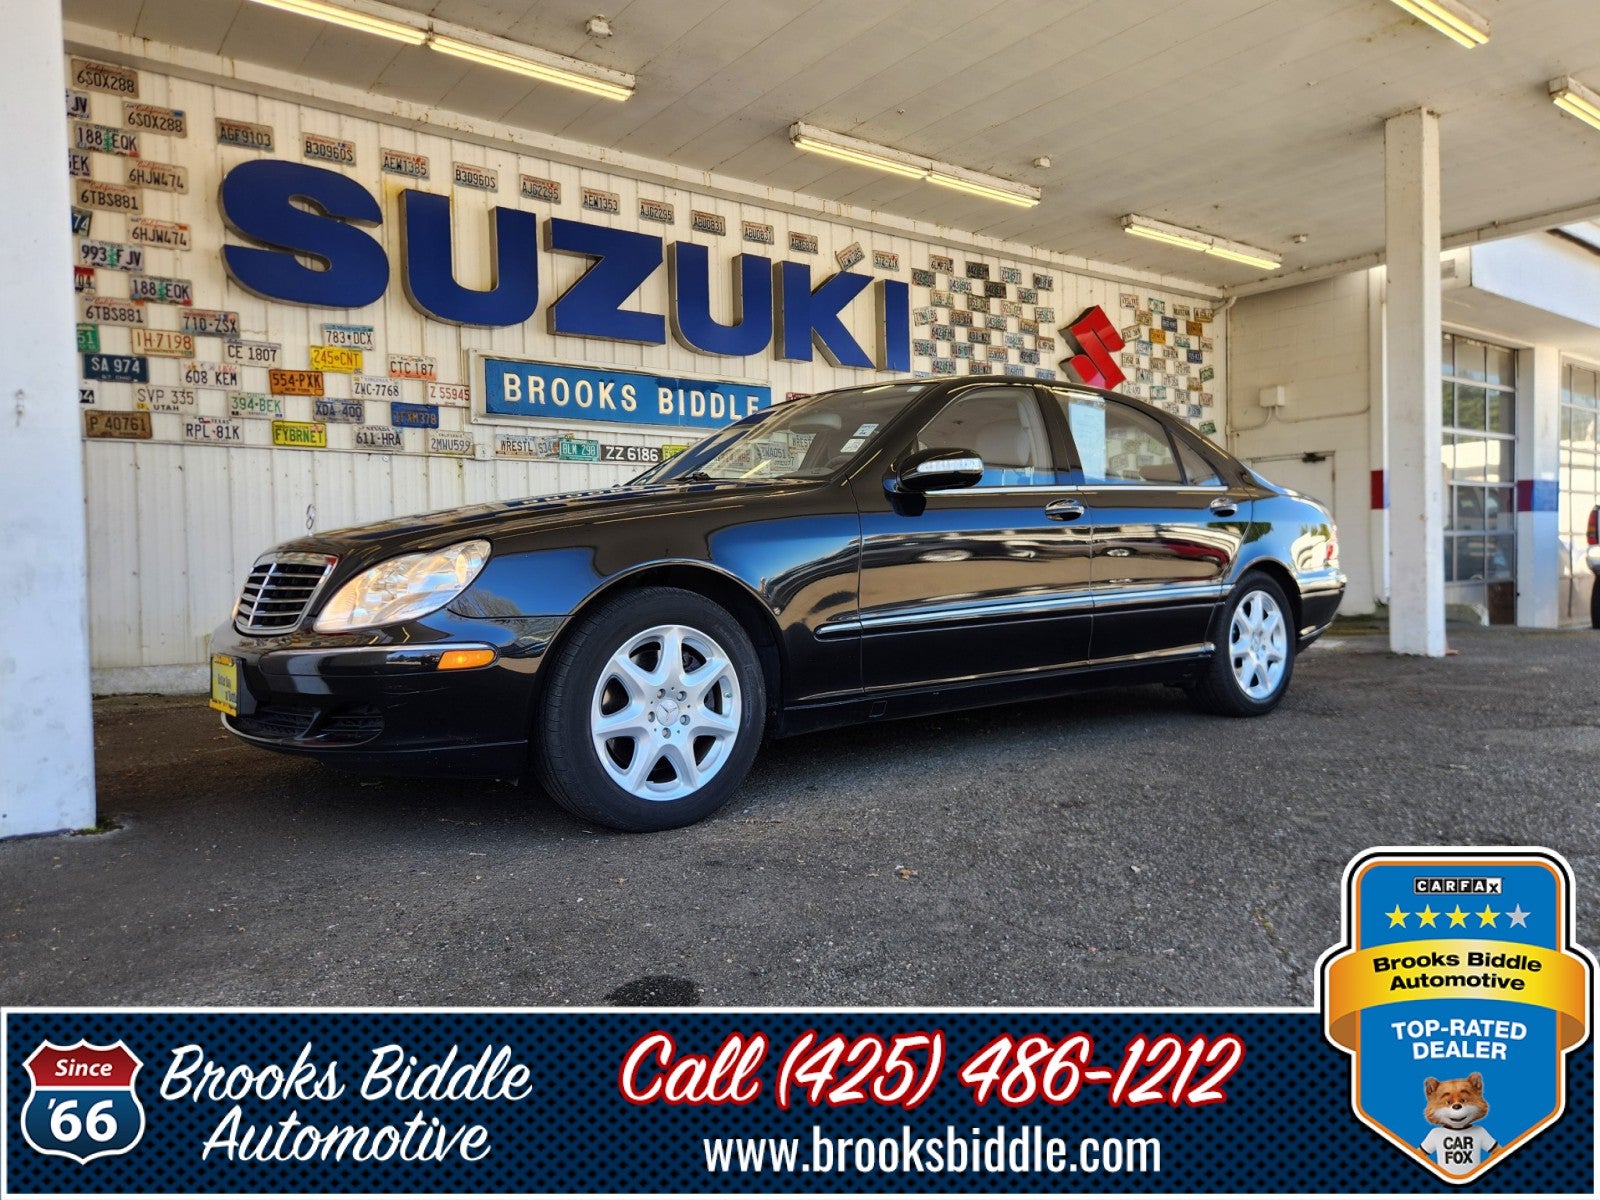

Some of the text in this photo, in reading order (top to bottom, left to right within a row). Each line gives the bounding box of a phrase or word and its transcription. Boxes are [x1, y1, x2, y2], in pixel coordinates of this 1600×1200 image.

[77, 127, 103, 146] 188
[128, 168, 184, 189] 6HJW474
[81, 189, 139, 210] 6TBS881
[132, 226, 187, 246] 6HJW474
[82, 245, 107, 262] 993
[221, 158, 911, 374] SUZUKI
[132, 279, 157, 296] 188
[85, 305, 143, 323] 6TBS881
[248, 347, 278, 362] 1807
[92, 357, 140, 374] SA 974
[415, 363, 434, 377] 187
[185, 369, 208, 385] 608
[137, 388, 194, 406] SVP 335
[430, 385, 437, 399] Z
[503, 371, 638, 413] BROOKS
[153, 404, 179, 412] UTAH
[104, 417, 148, 432] 40761
[605, 445, 624, 461] ZZ
[627, 447, 659, 463] 6186
